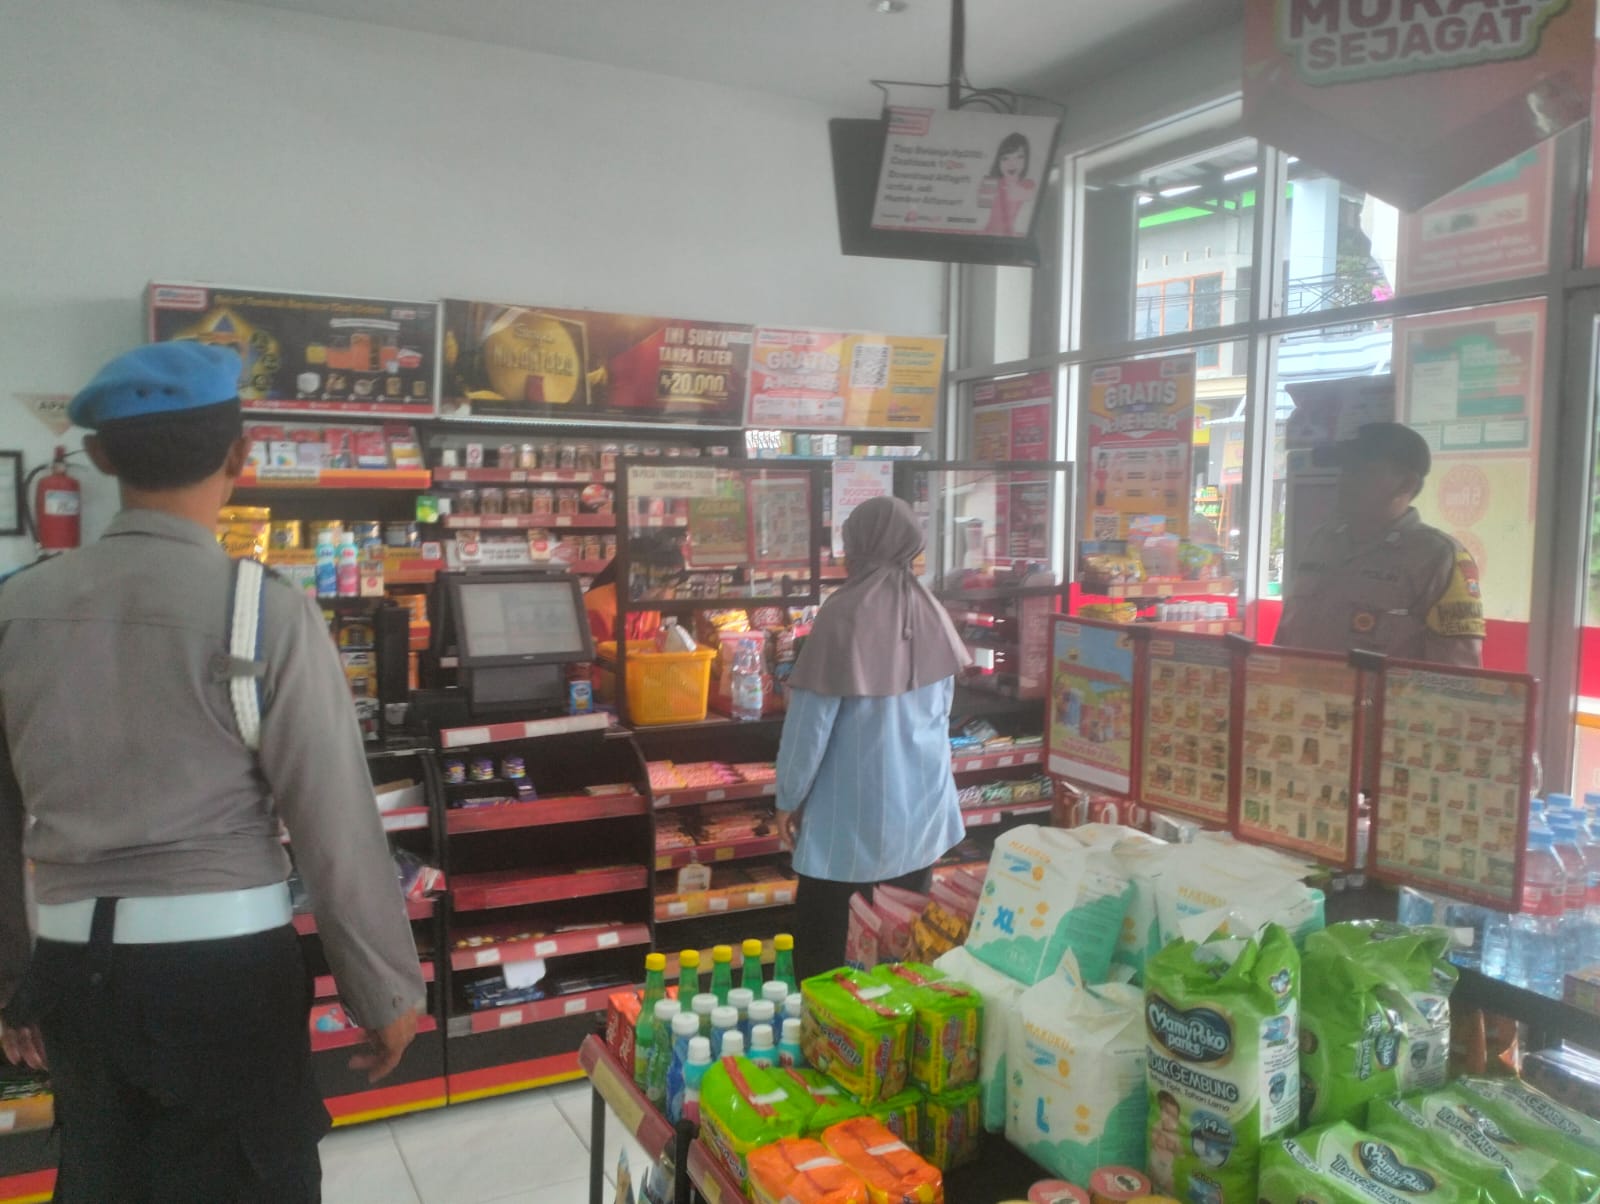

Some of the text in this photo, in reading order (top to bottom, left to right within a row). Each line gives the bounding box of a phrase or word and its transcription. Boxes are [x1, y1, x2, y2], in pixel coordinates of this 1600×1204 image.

[1307, 6, 1532, 70] SEJAGAT
[1104, 380, 1178, 409] GRATIS
[992, 904, 1014, 935] XL
[1203, 1118, 1218, 1131] 14
